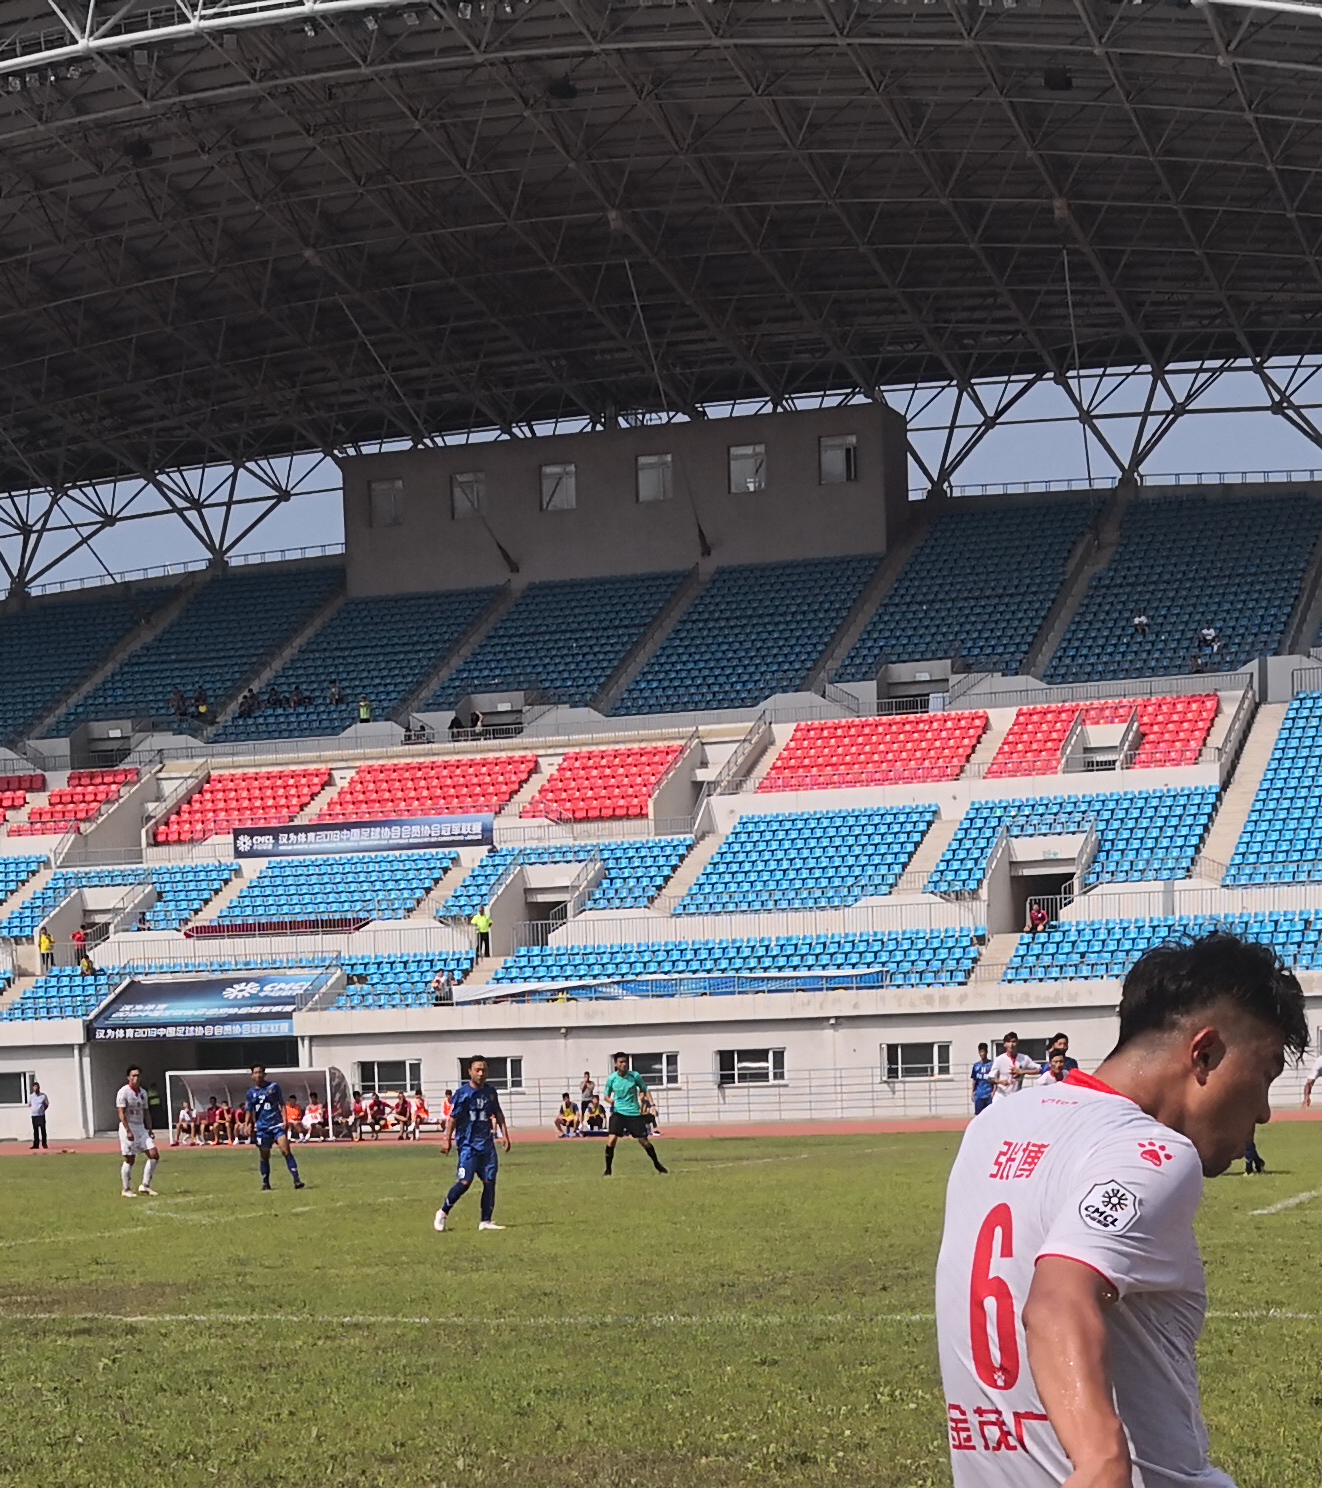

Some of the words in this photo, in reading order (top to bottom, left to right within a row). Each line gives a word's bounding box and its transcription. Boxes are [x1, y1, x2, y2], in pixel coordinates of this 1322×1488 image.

[989, 1140, 1050, 1180] 张博
[1084, 1204, 1119, 1228] CMCL
[970, 1203, 1020, 1391] 6
